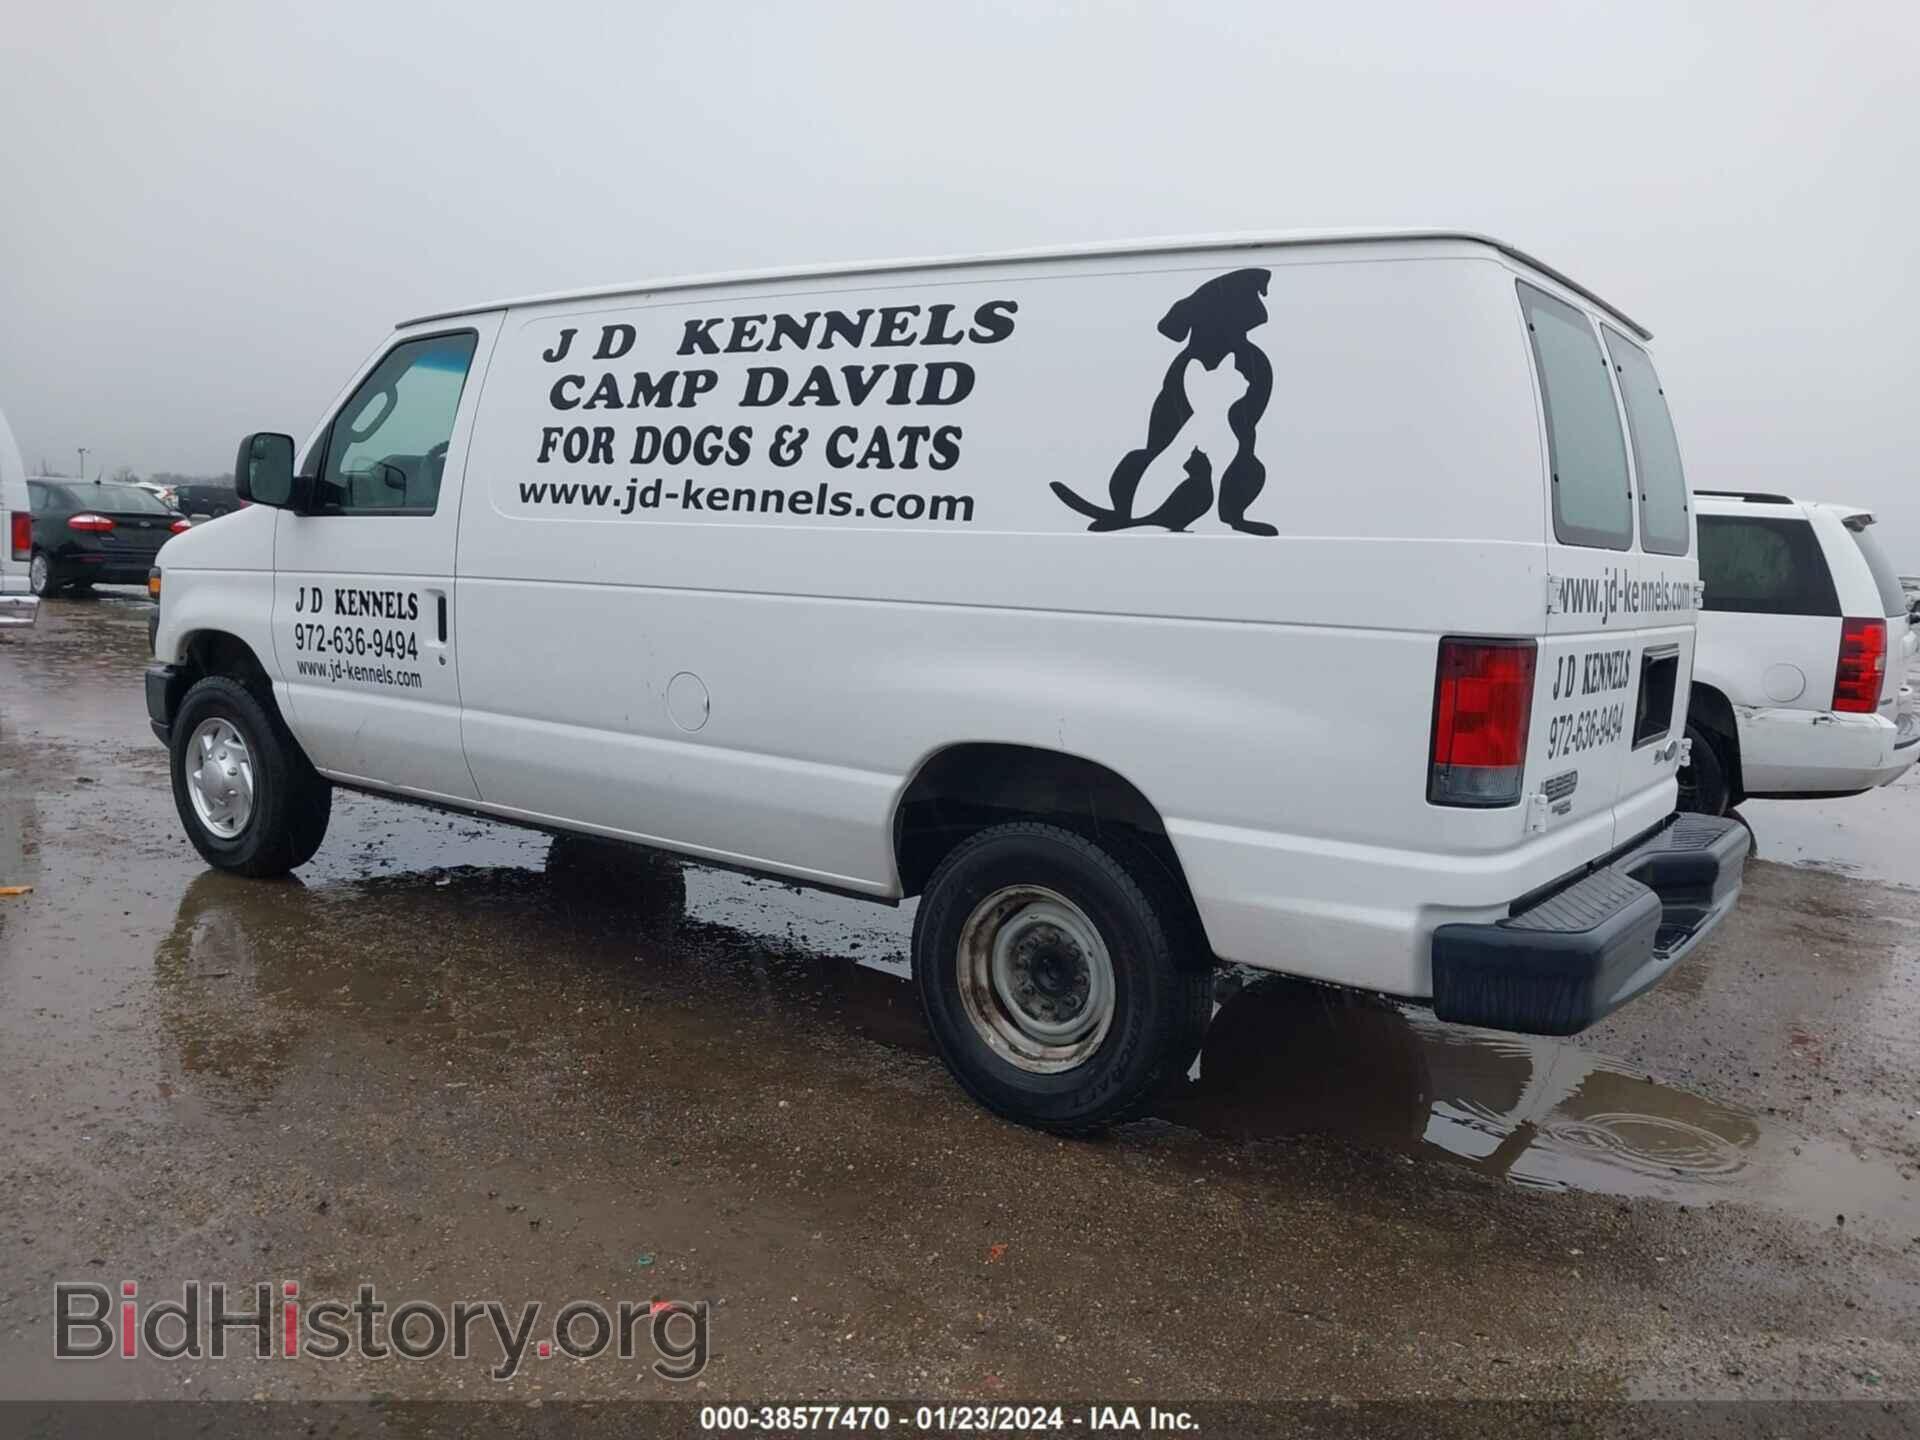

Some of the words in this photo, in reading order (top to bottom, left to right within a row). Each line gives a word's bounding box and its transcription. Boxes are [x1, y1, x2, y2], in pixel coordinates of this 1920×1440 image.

[542, 328, 578, 363] J
[592, 323, 637, 360] D
[676, 300, 1019, 356] KENNELS
[549, 370, 719, 411] CAMP
[738, 361, 976, 408] DAVID
[536, 425, 616, 465] FOR
[629, 424, 754, 467] DOGS
[768, 424, 810, 468] &
[825, 425, 963, 471] CATS
[519, 477, 975, 522] www.jd-kennels.com
[295, 586, 305, 613] J
[310, 586, 323, 614] D
[334, 588, 419, 621] KENNELS
[294, 622, 419, 662] 972-636-9494
[296, 658, 423, 689] www.jd-kennels.com
[1552, 655, 1565, 700] J
[1563, 654, 1577, 699] D
[1581, 649, 1632, 697] KENNELS
[1547, 702, 1625, 760] 972-636-9494
